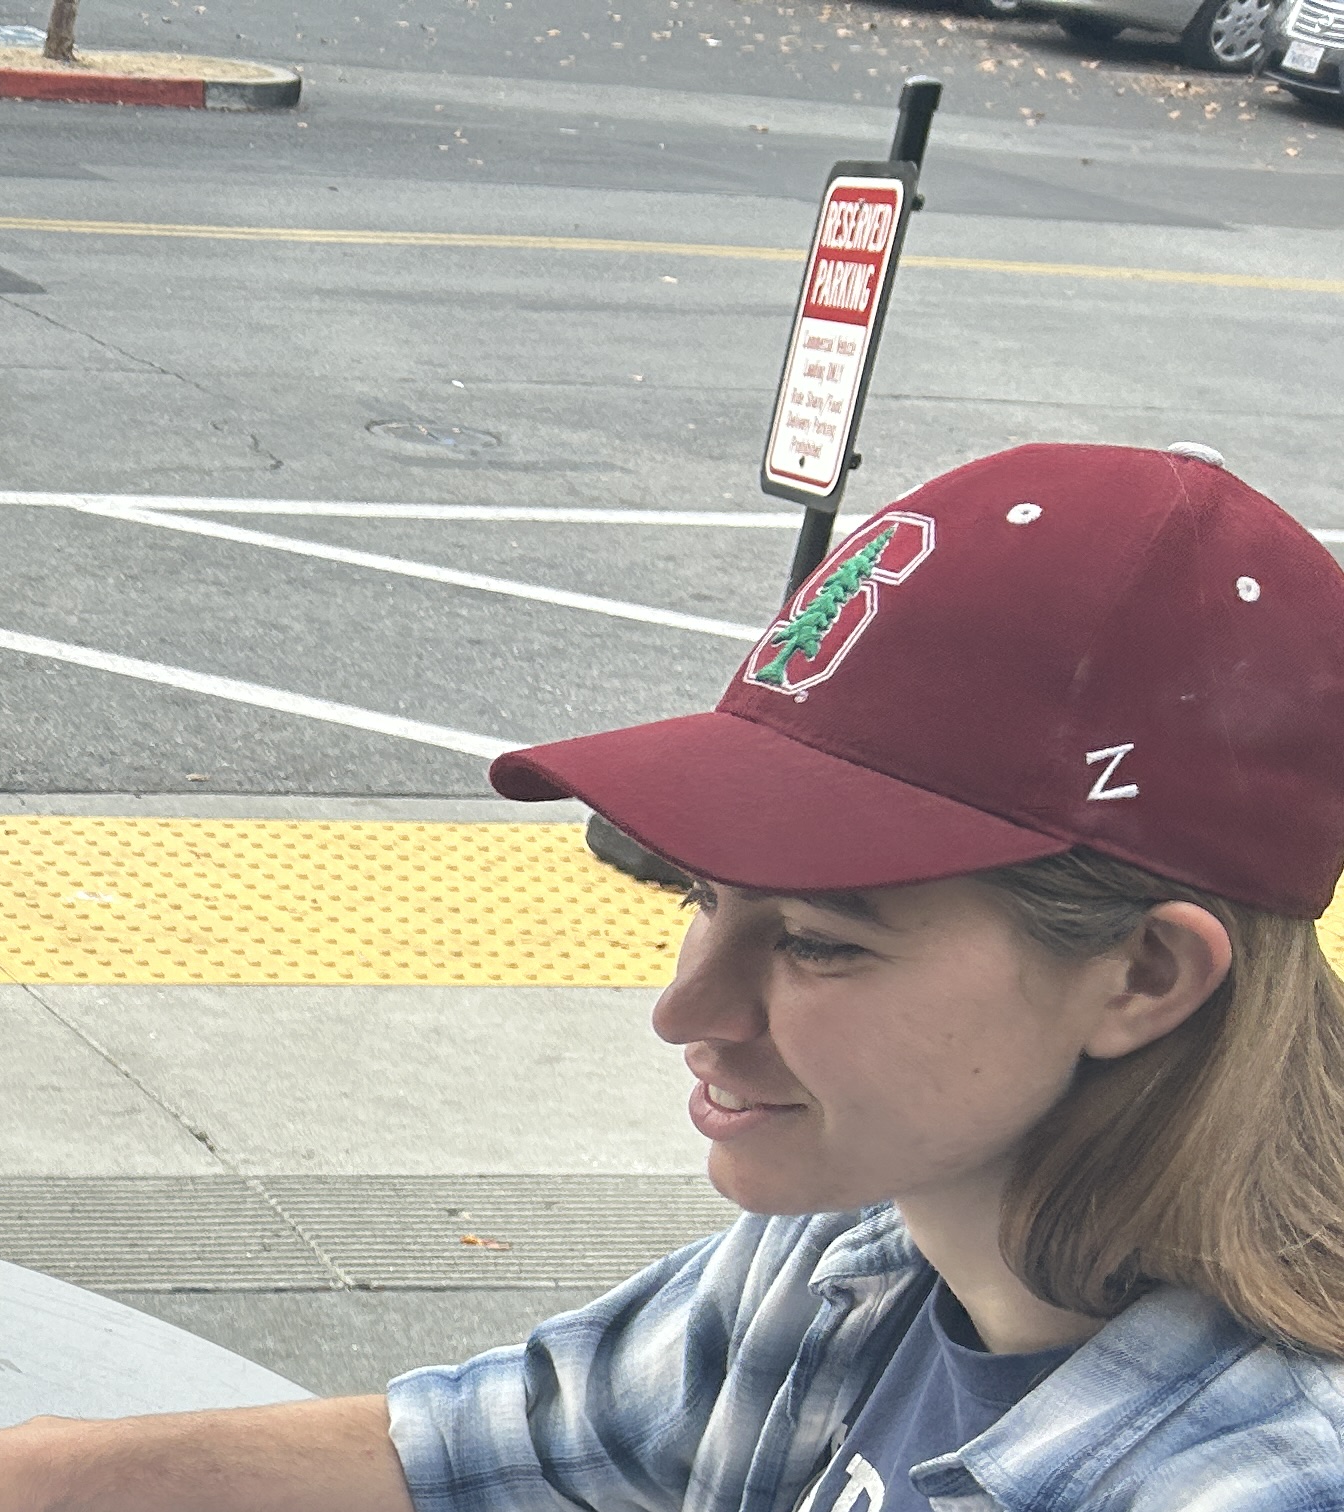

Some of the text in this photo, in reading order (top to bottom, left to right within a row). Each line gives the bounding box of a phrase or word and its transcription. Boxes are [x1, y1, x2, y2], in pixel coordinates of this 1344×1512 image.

[821, 201, 893, 253] RESERVED
[811, 260, 874, 312] PARKING
[1085, 742, 1140, 801] Z
